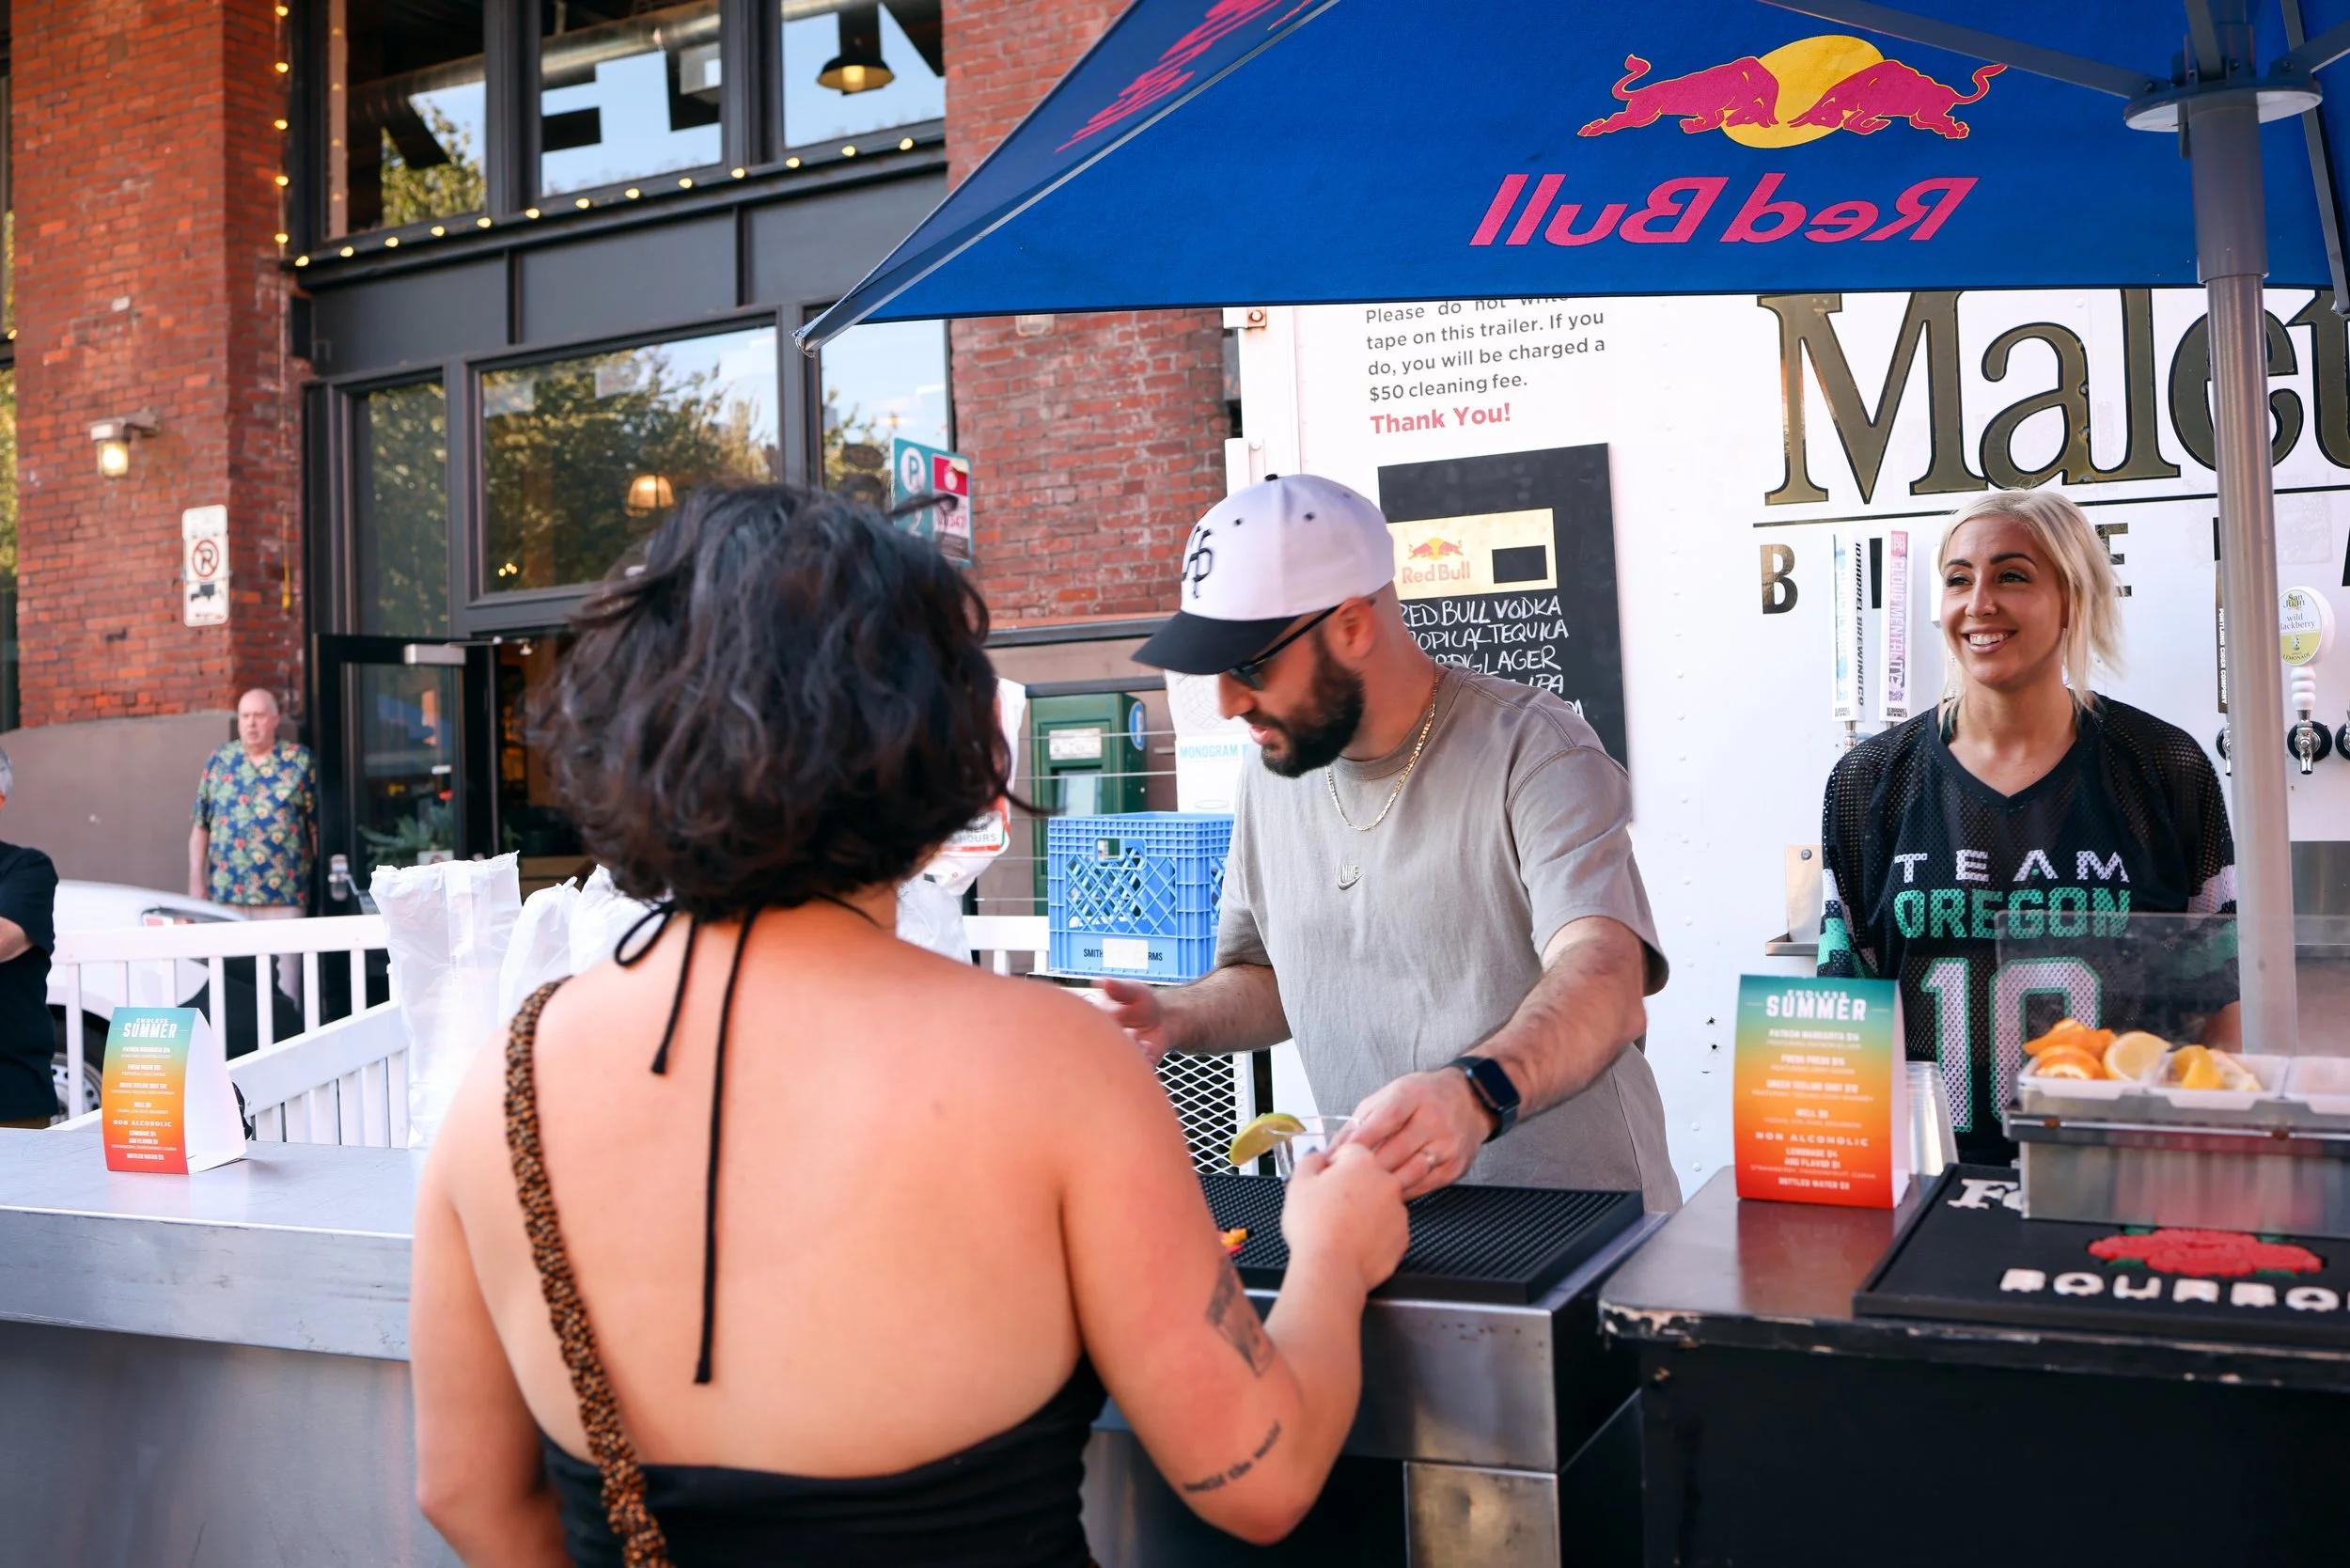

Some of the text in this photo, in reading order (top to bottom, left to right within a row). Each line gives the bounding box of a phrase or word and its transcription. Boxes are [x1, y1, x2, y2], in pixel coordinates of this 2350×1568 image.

[1366, 306, 1426, 324] Please
[1438, 301, 1462, 316] do
[1475, 299, 1507, 312] not
[1367, 312, 1605, 352] tape on this trailer. If you
[1368, 337, 1606, 377] do, you will be charged a
[1370, 373, 1528, 403] $50 cleaning fee.
[1370, 402, 1512, 434] Thank You!
[1402, 561, 1471, 584] Red Bull
[1442, 601, 1491, 626] BULL
[1494, 595, 1562, 619] VODKA
[2287, 613, 2304, 622] wild
[1409, 619, 1569, 651] OPICAL TEQUILA
[2280, 620, 2316, 631] lackberry
[1484, 645, 1562, 675] LAGER
[1179, 744, 1239, 760] MONOGRAM
[1341, 863, 1360, 882] NIKE
[1894, 848, 2131, 884] TEAM
[1894, 886, 2131, 940] OREGON
[1083, 948, 1163, 962] SMITH RMS
[1765, 995, 1868, 1021] SUMMER
[123, 1022, 178, 1039] SUMMER
[1920, 956, 2102, 1133] 10
[131, 1120, 173, 1128] ALCOHOLIC
[1755, 1131, 1870, 1147] NON ALCOHOLIC
[1999, 1267, 2350, 1312] BOURBO
